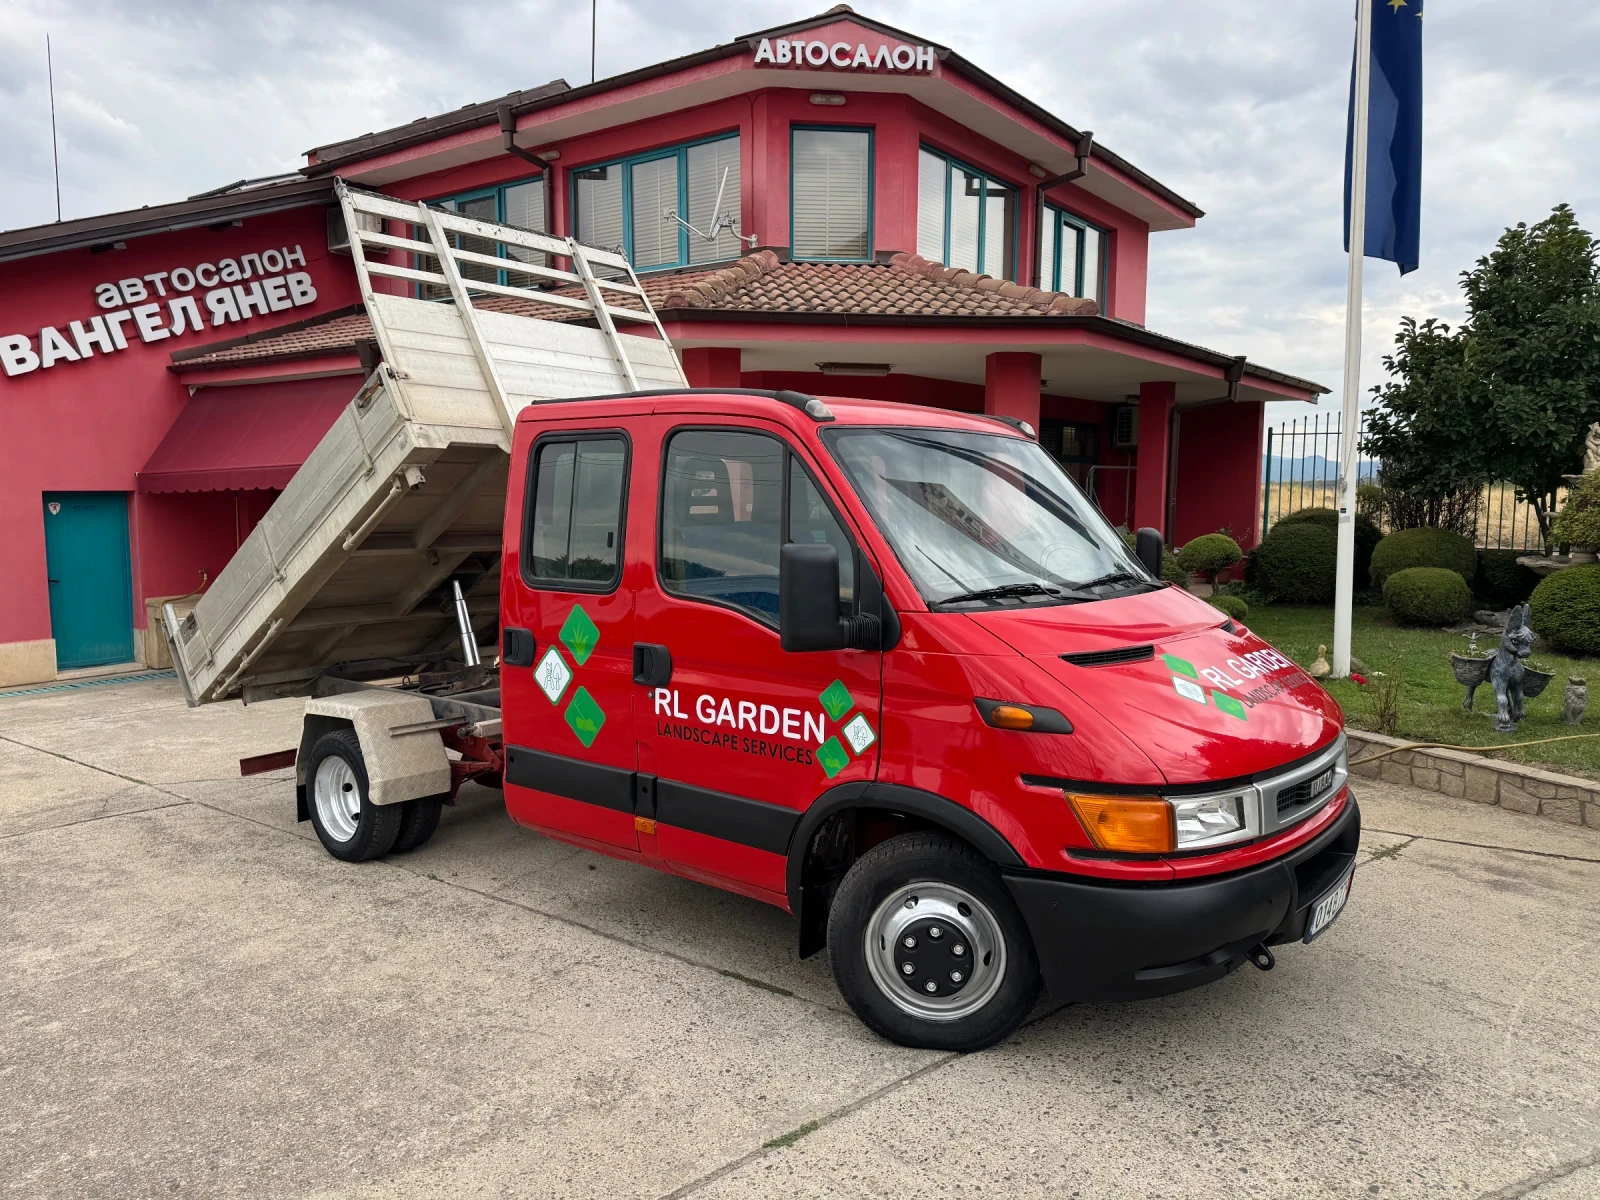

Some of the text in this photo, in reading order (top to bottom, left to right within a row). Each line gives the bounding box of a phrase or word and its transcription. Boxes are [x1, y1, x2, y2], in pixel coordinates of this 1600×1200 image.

[753, 38, 935, 71] АВТОСАЛОН
[0, 271, 318, 377] ВАНГЕЛ ЯНЕВ
[1200, 648, 1294, 691] RL GARDEN
[655, 687, 826, 743] RL GARDEN
[657, 721, 813, 766] LANDSCAPE SERVICES
